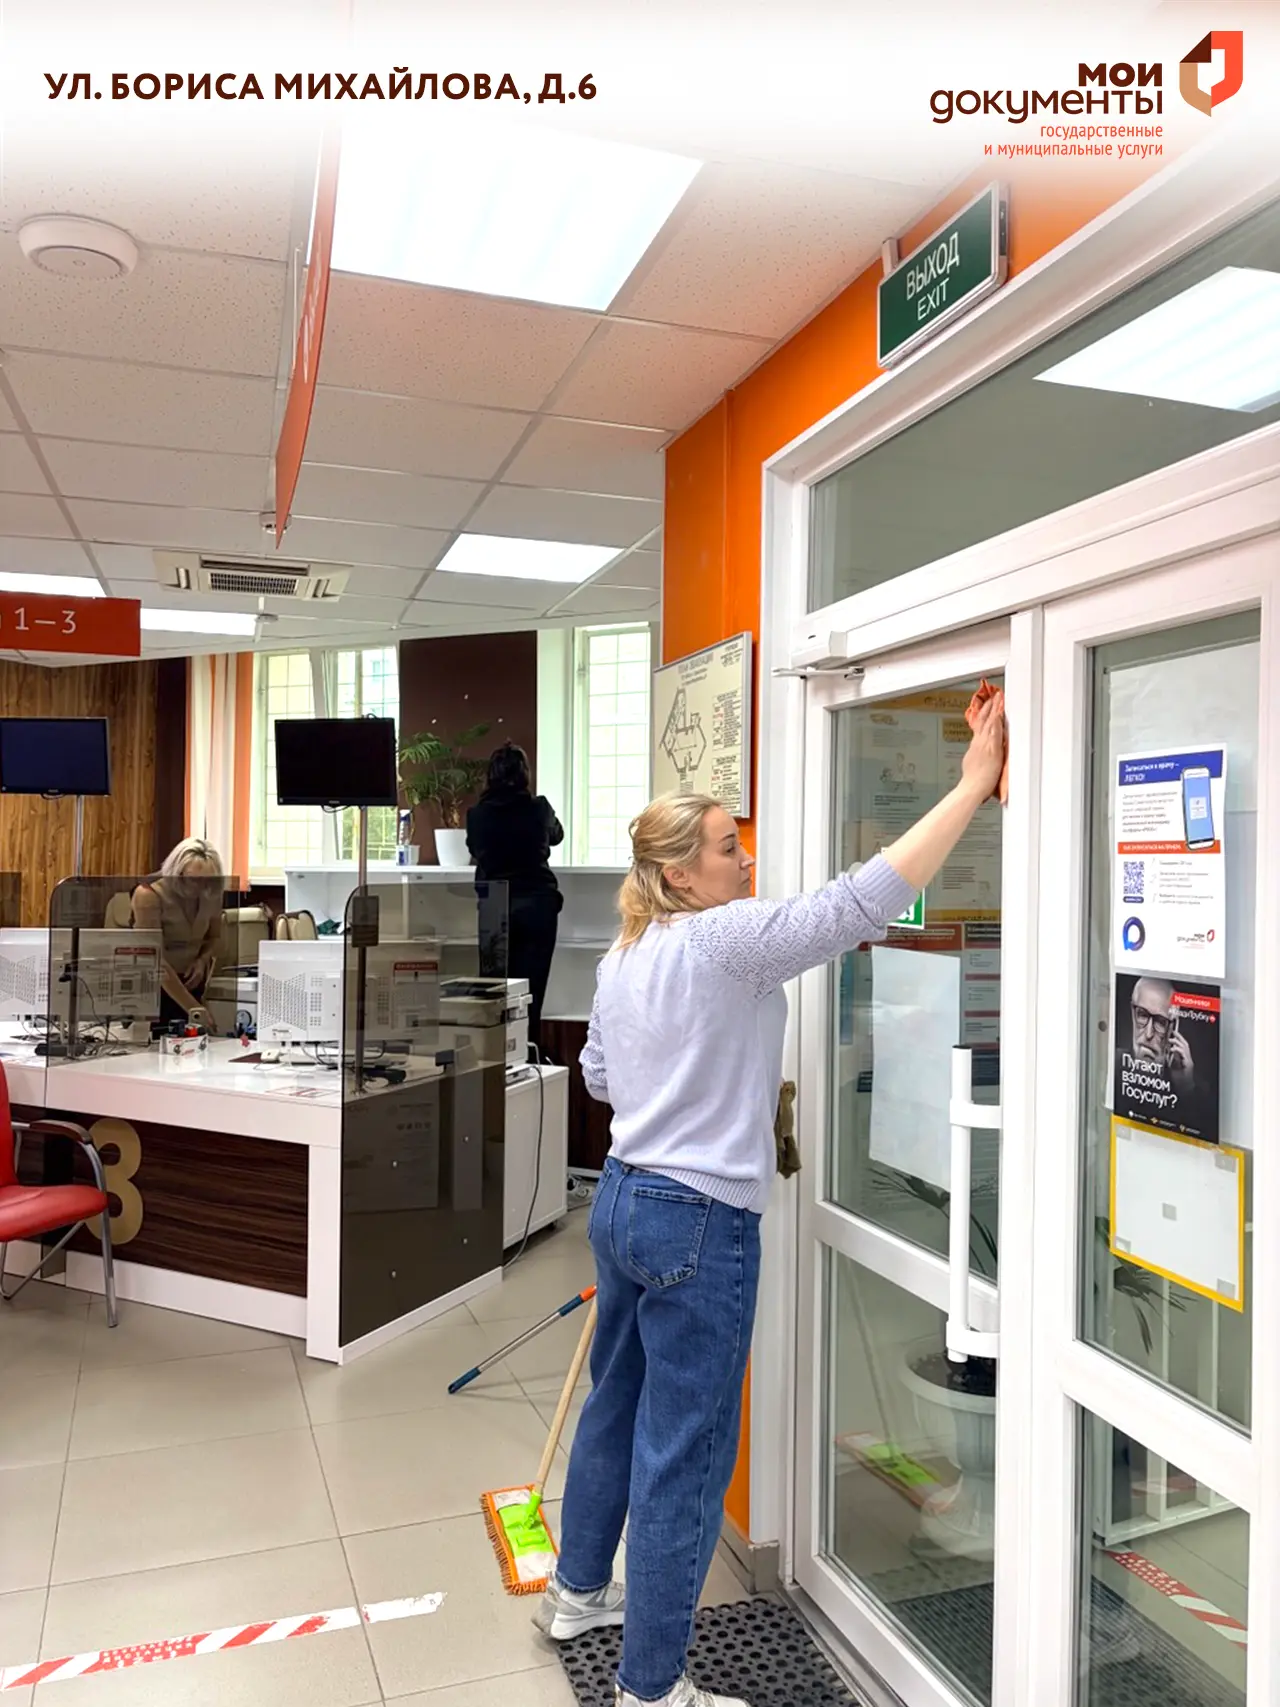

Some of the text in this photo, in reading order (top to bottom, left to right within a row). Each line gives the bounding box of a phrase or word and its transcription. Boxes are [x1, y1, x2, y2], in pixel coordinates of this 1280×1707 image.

[906, 232, 960, 300] ВЫХОД
[917, 278, 950, 320] EXIT
[1122, 1054, 1163, 1074] Пугают
[1122, 1071, 1170, 1092] взломом
[1122, 1083, 1178, 1108] Госуслуг?
